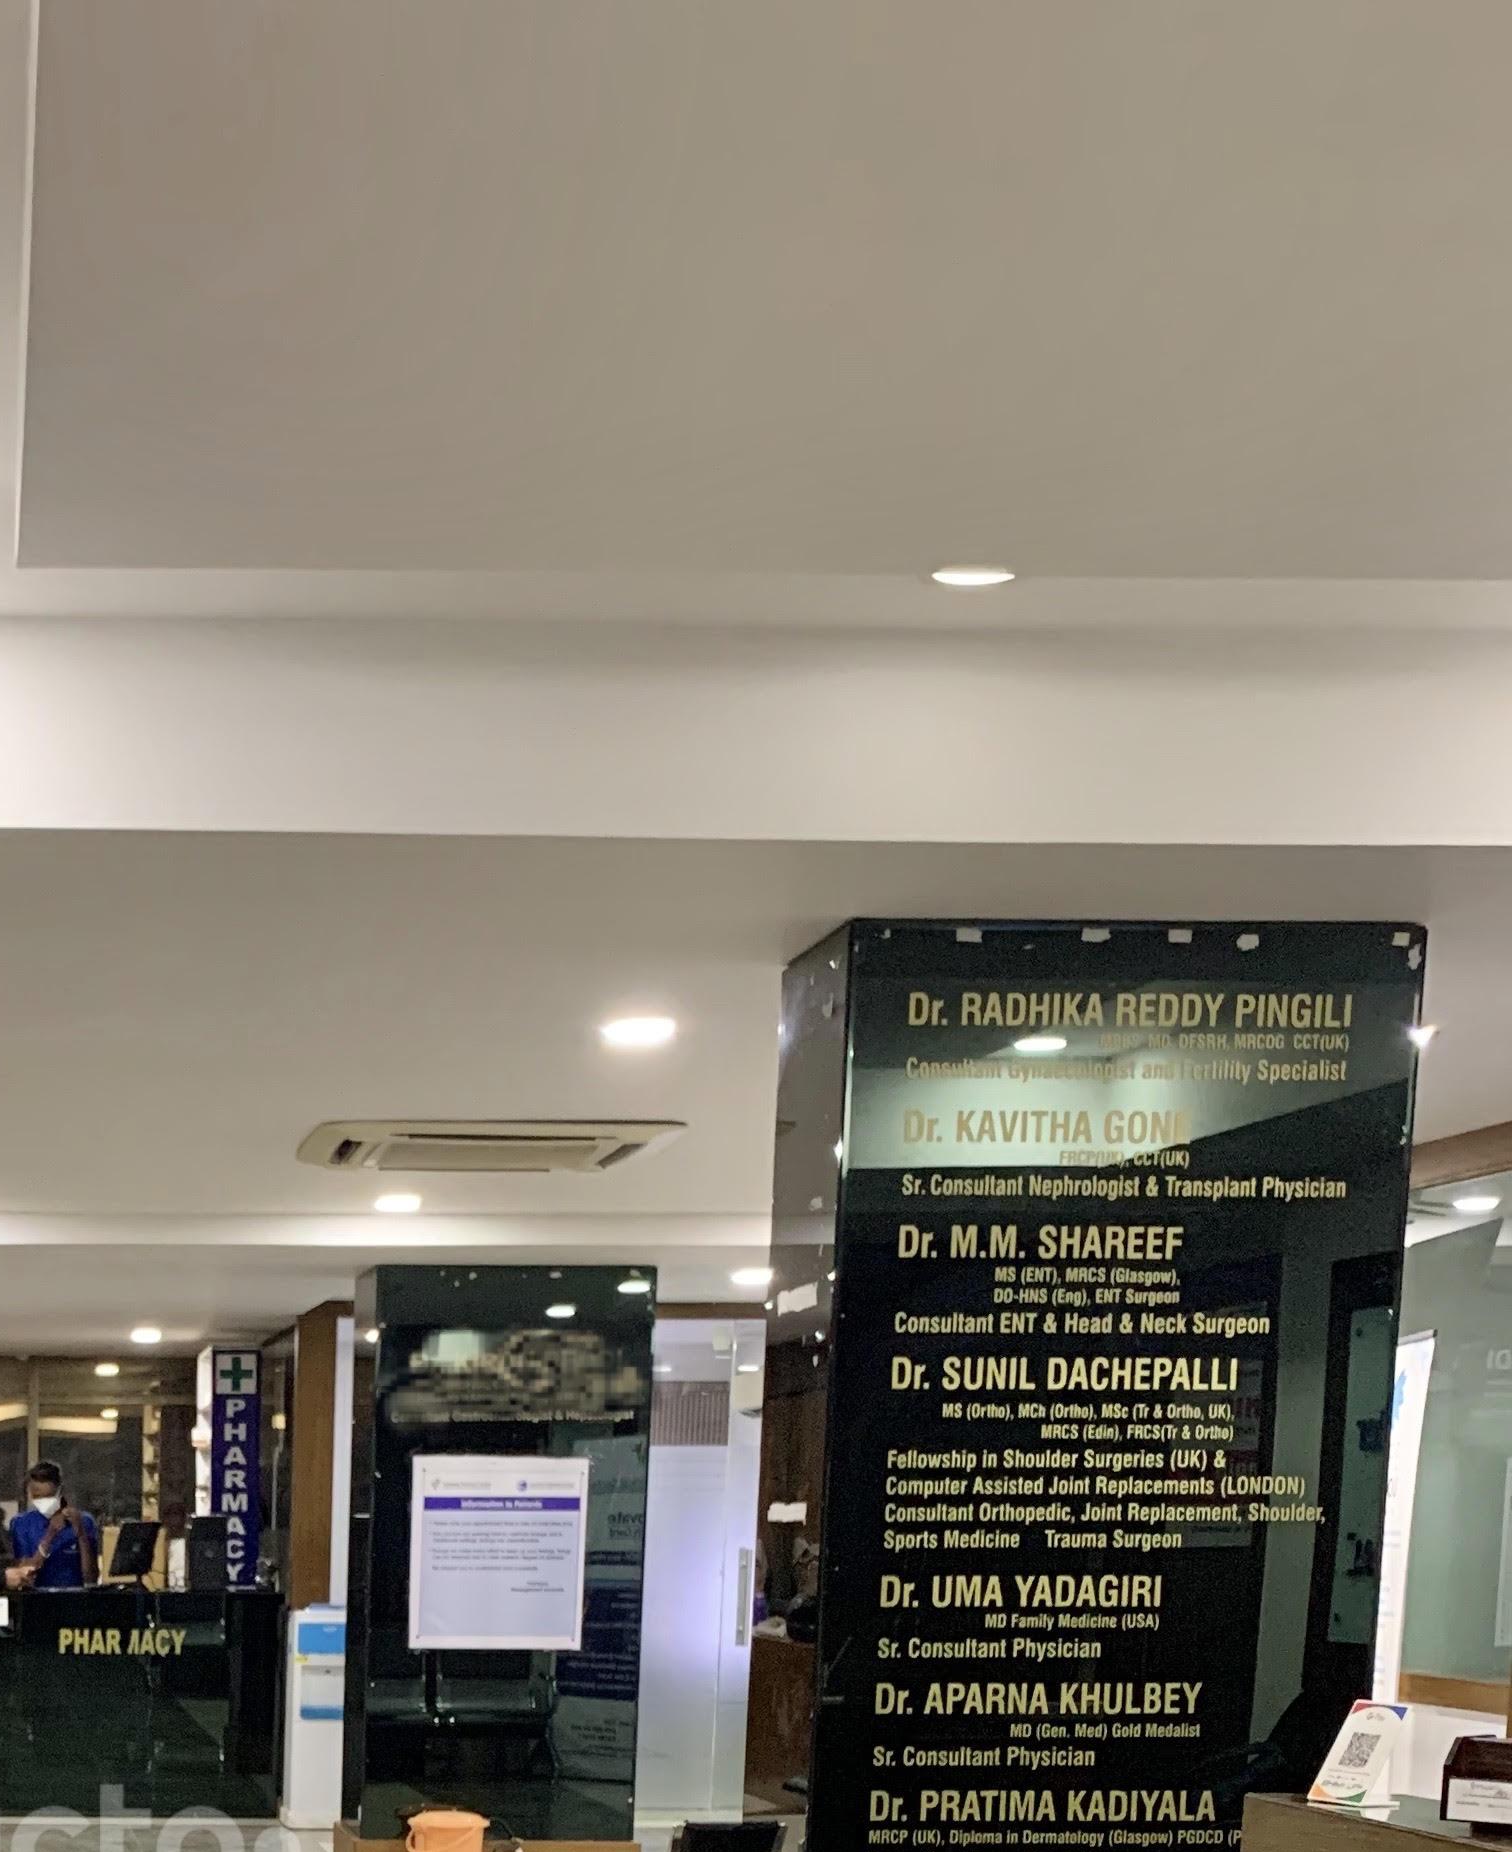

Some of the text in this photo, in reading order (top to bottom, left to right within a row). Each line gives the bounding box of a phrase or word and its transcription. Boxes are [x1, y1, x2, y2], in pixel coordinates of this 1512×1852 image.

[908, 992, 1353, 1028] Dr. RADHIKA REDDY PINGILI
[906, 1057, 1001, 1079] Consultant
[1142, 1058, 1176, 1080] and
[1256, 1059, 1346, 1084] Specialist
[903, 1110, 942, 1143] Dr.
[955, 1110, 1092, 1143] KAVITHA
[1133, 1150, 1191, 1169] CCT(UK)
[902, 1174, 1347, 1202] Sr. Consultant Nephrologist & Transplant Physician
[898, 1224, 1185, 1260] Dr. M.M. SHAREEF
[994, 1267, 1016, 1283] MS
[1021, 1267, 1061, 1285] (ENT),
[1065, 1267, 1106, 1283] MRCS
[1095, 1289, 1121, 1304] ENT
[1125, 1289, 1180, 1307] Surgeon
[894, 1311, 1270, 1339] Consultant ENT & Head & Neck Surgeon
[891, 1356, 1238, 1390] Dr. SUNIL DACHEPALLI
[942, 1403, 962, 1418] MS
[966, 1403, 1014, 1421] (Ortho),
[1018, 1403, 1046, 1418] MCh
[1050, 1403, 1097, 1421] (Ortho),
[1101, 1404, 1129, 1419] MSc
[1132, 1404, 1150, 1421] (Tr
[1153, 1404, 1163, 1419] &
[1041, 1424, 1079, 1439] MRCS
[1181, 1425, 1191, 1440] &
[1195, 1425, 1234, 1441] Ortho)
[887, 1449, 1227, 1472] Fellowship in Shoulder Surgeries (UK) &
[221, 1398, 249, 1582] PHARMACY
[886, 1476, 1305, 1499] Computer Assisted Joint Replacements (LONDON)
[885, 1503, 1326, 1525] Consultant Orthopedic, Joint Replacement, Shoulder,
[883, 1529, 1182, 1553] Sports Medicine Trauma Surgeon
[879, 1574, 1162, 1608] Dr. UMA YADAGIRI
[984, 1614, 1159, 1631] MD Family Medicine (USA)
[877, 1637, 1101, 1662] Sr. Consultant Physician
[875, 1682, 1203, 1715] Dr. APARNA KHULBEY
[1010, 1723, 1200, 1741] MD (Gen. Med) Gold Medalist
[873, 1746, 1095, 1770] Sr. Consultant Physician
[869, 1790, 1216, 1822] Dr. PRATIMA KADIYALA
[868, 1829, 908, 1844] MRCP
[912, 1829, 945, 1847] (UK),
[949, 1829, 1002, 1847] Diploma
[1007, 1830, 1018, 1844] in
[1022, 1829, 1104, 1847] Dermatology
[1108, 1829, 1173, 1847] (Glasgow)
